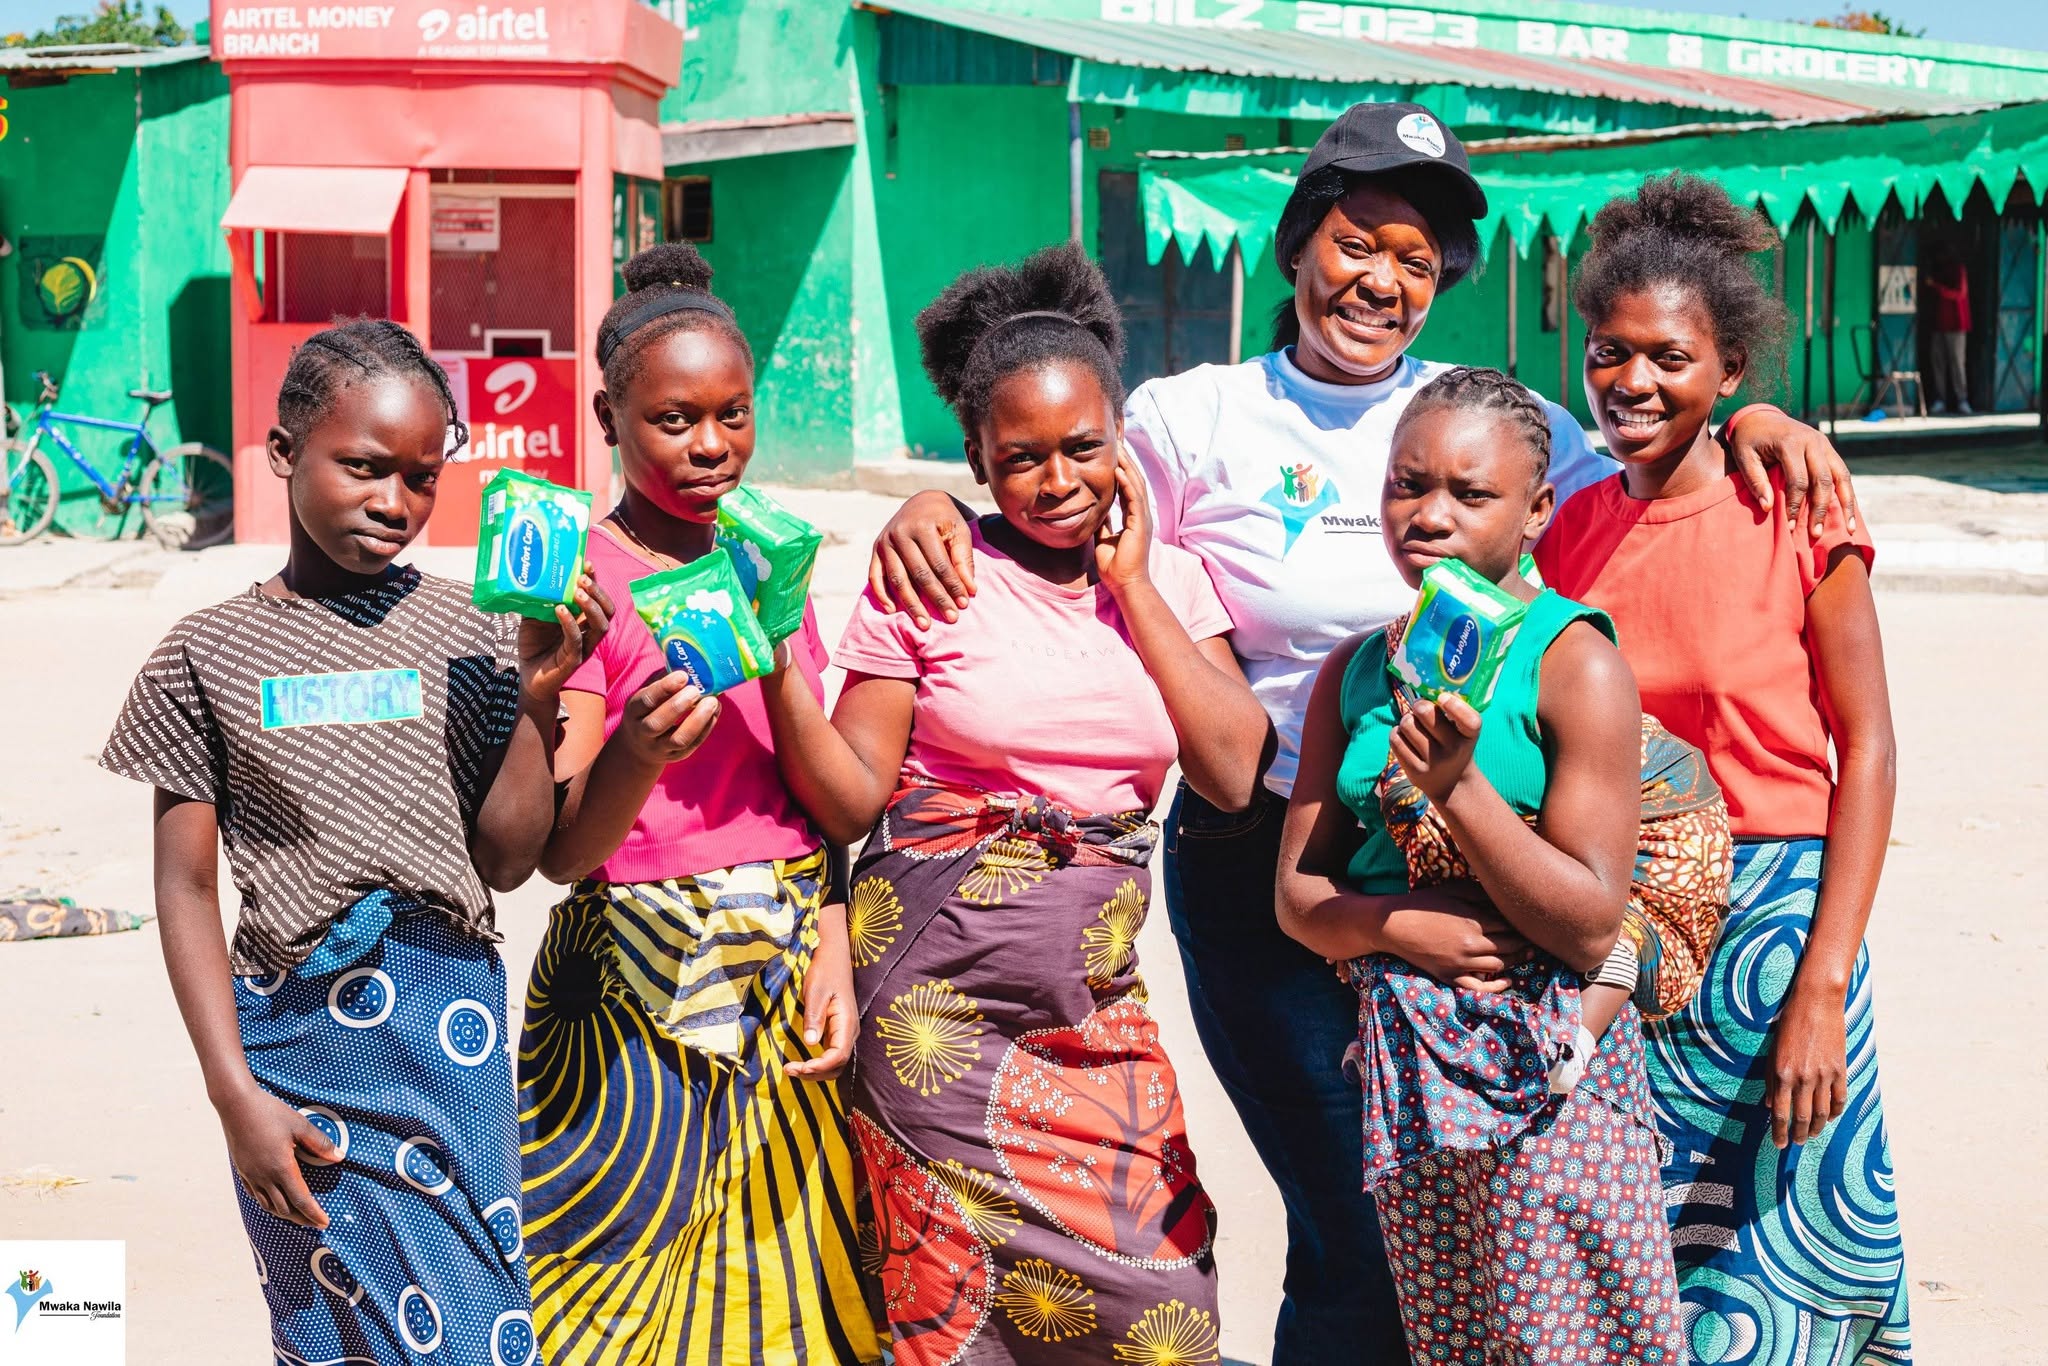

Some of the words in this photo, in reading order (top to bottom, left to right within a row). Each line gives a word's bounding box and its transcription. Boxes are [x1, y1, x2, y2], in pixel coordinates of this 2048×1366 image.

[223, 8, 303, 29] AIRTEL
[308, 6, 395, 28] MONEY
[456, 5, 549, 40] airtel
[223, 33, 319, 55] BRANCH
[1100, 0, 1263, 29] BILZ
[1296, 2, 1478, 48] 2023
[1518, 21, 1628, 61] BAR
[1728, 39, 1936, 88] GROCERY
[523, 522, 534, 545] Care
[518, 545, 531, 585] Comfort
[236, 624, 261, 639] Stone
[400, 611, 416, 622] and
[442, 635, 467, 651] Stone
[408, 603, 424, 614] and
[450, 626, 475, 641] Stone
[416, 596, 433, 605] and
[459, 616, 483, 631] Stone
[467, 606, 491, 622] Stone
[219, 644, 244, 658] Stone
[227, 634, 252, 647] Stone
[245, 616, 270, 629] Stone
[321, 650, 348, 666] better
[254, 608, 279, 619] Stone
[330, 641, 358, 659] better
[356, 656, 374, 665] and
[338, 632, 367, 649] better
[364, 646, 382, 656] and
[347, 623, 374, 638] better
[373, 637, 391, 647] and
[417, 660, 442, 677] Stone
[382, 628, 399, 638] and
[425, 652, 450, 668] Stone
[391, 619, 408, 632] and
[434, 643, 458, 660] Stone
[674, 641, 688, 661] Care
[1456, 620, 1475, 655] Comfort
[203, 664, 228, 680] Stone
[211, 654, 236, 668] Stone
[683, 661, 706, 694] Comfort
[160, 694, 175, 709] and
[267, 673, 416, 723] HISTORY
[127, 710, 139, 725] and
[157, 752, 178, 776] Stone
[137, 705, 151, 720] and
[170, 747, 191, 771] Stone
[148, 699, 162, 715] and
[181, 741, 203, 764] Stone
[359, 731, 385, 750] Stone
[145, 758, 166, 782] Stone
[286, 737, 304, 748] and
[332, 759, 360, 778] Stone
[410, 809, 436, 829] better
[435, 828, 451, 840] and
[341, 749, 368, 769] Stone
[419, 798, 445, 818] better
[351, 740, 377, 760] Stone
[428, 788, 452, 807] better
[249, 747, 271, 763] better
[271, 761, 287, 771] and
[315, 780, 343, 798] Stone
[393, 830, 418, 849] better
[418, 849, 434, 860] and
[252, 734, 279, 753] better
[277, 749, 295, 759] and
[323, 770, 350, 788] Stone
[400, 820, 426, 839] better
[425, 838, 442, 851] and
[301, 804, 325, 821] Stone
[380, 847, 410, 869] better
[407, 865, 424, 877] and
[307, 792, 334, 809] Stone
[387, 838, 413, 857] better
[414, 856, 430, 868] and
[371, 858, 399, 876] better
[397, 875, 416, 887] and
